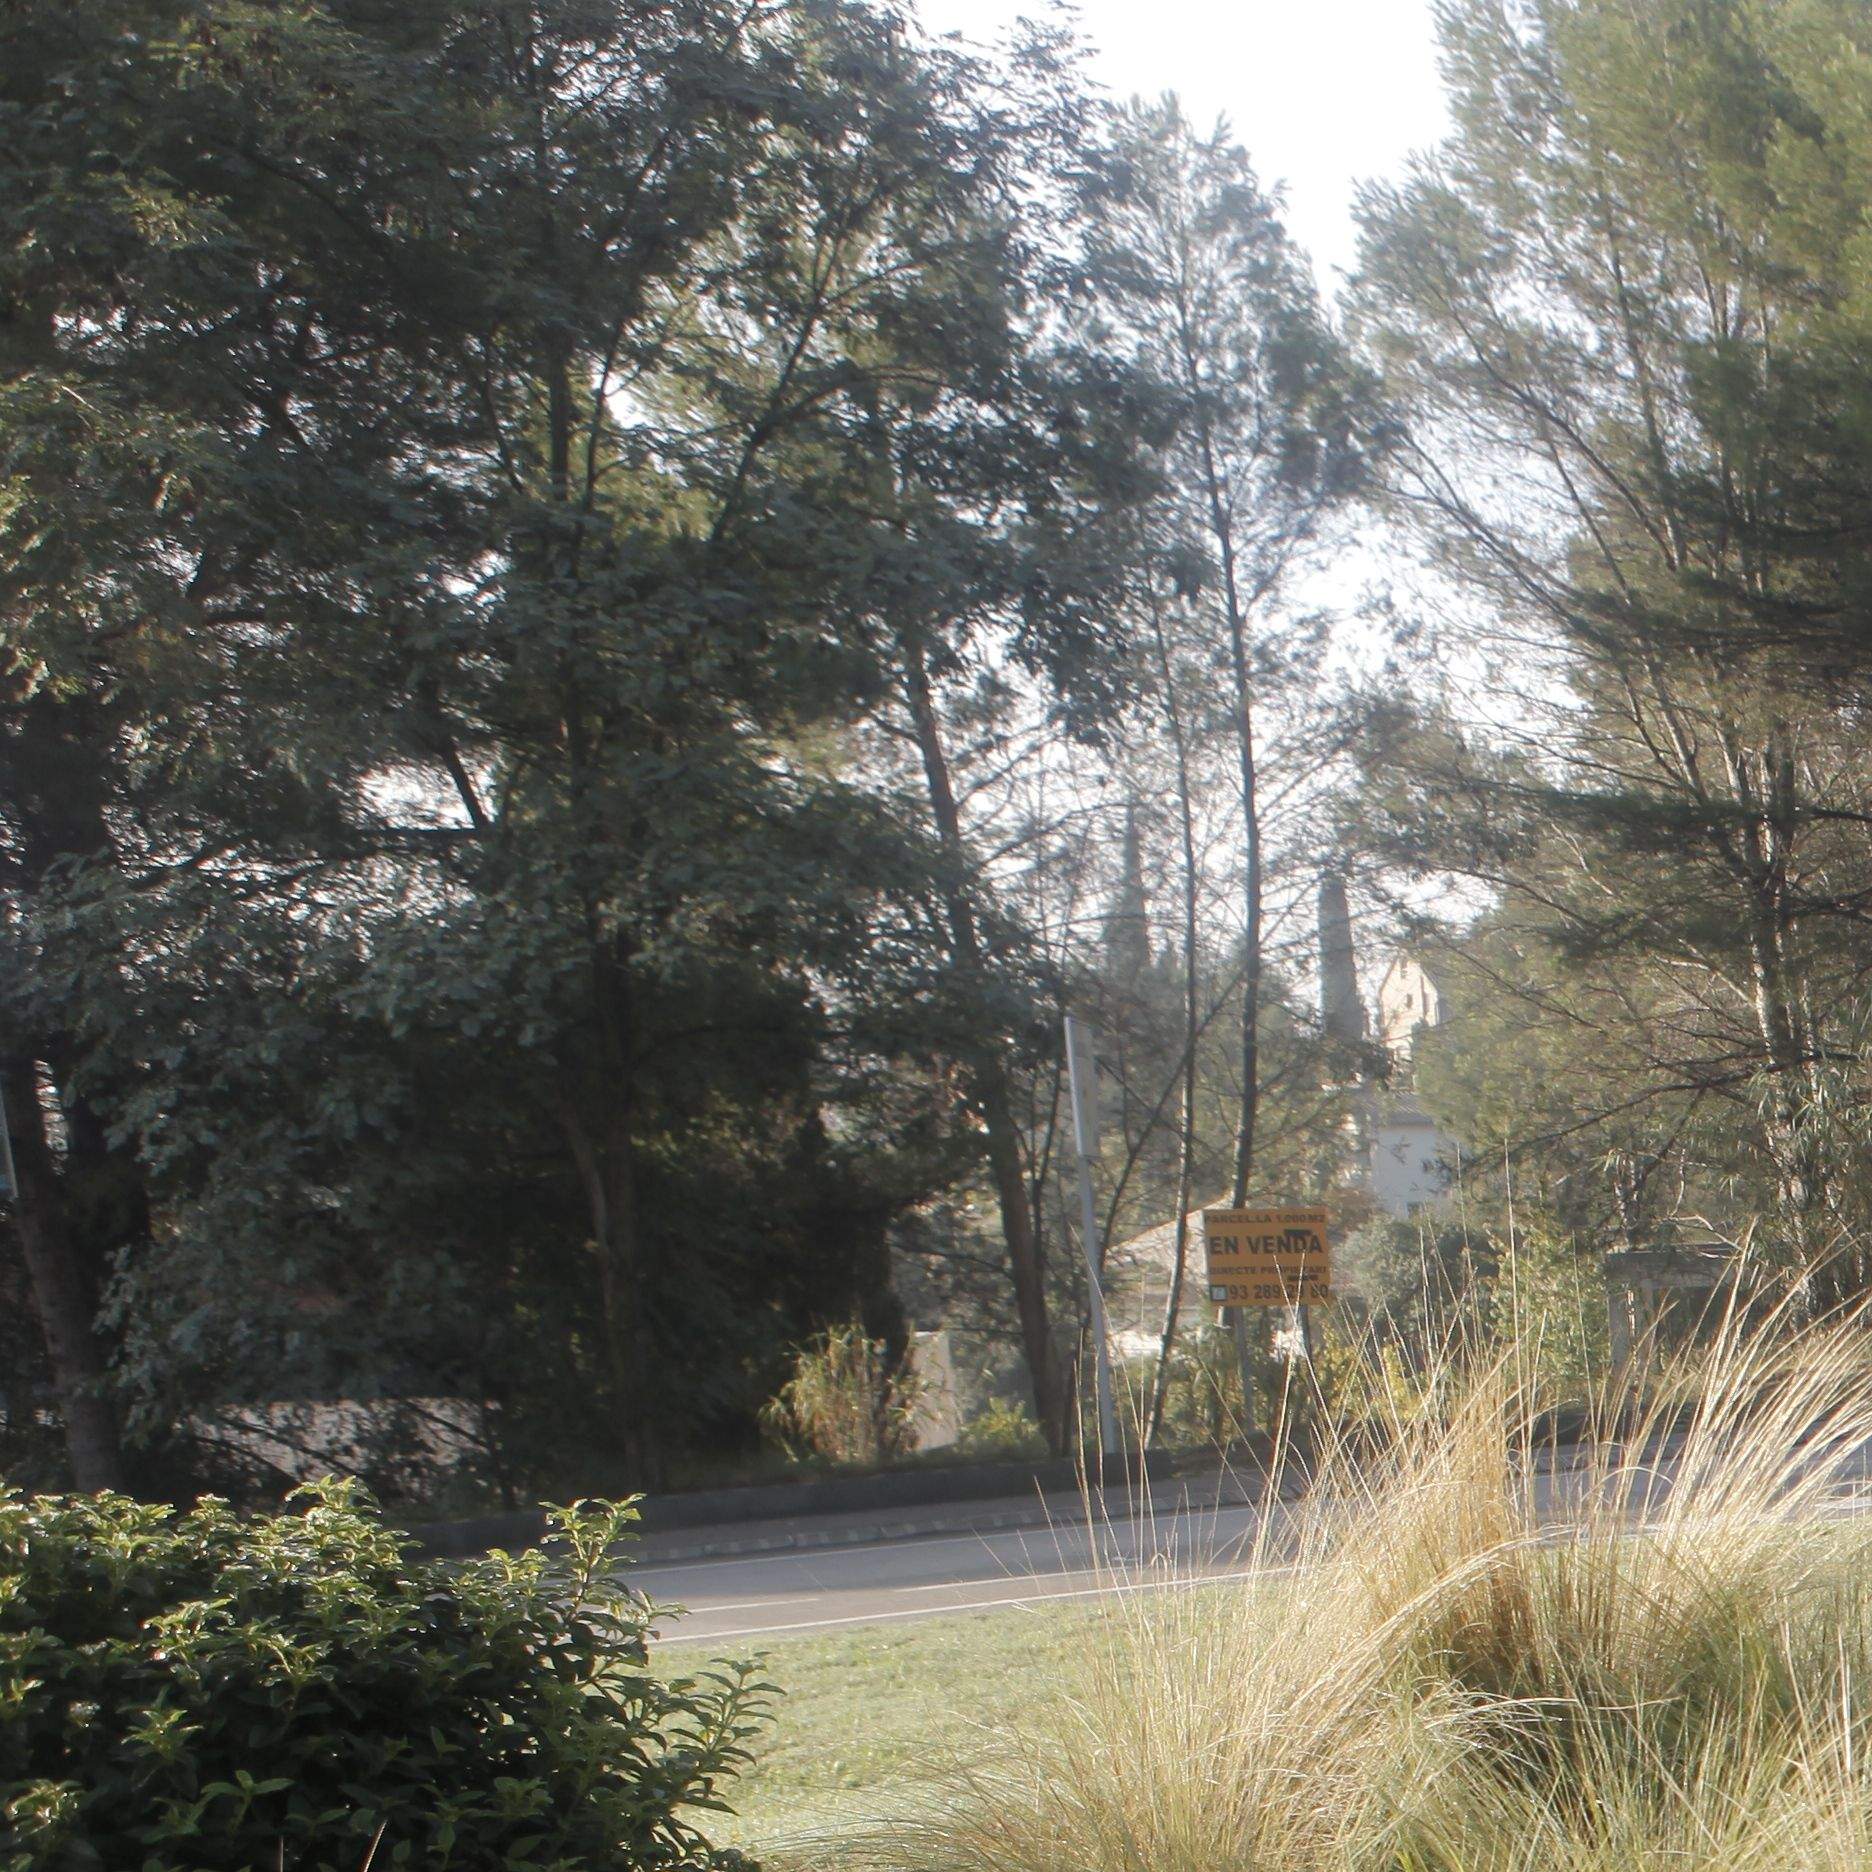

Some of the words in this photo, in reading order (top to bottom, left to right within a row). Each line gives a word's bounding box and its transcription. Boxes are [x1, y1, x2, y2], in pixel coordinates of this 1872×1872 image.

[1209, 1236, 1239, 1255] EN
[1246, 1234, 1322, 1254] VENDA
[1229, 1284, 1248, 1299] 93
[1253, 1284, 1281, 1299] 289
